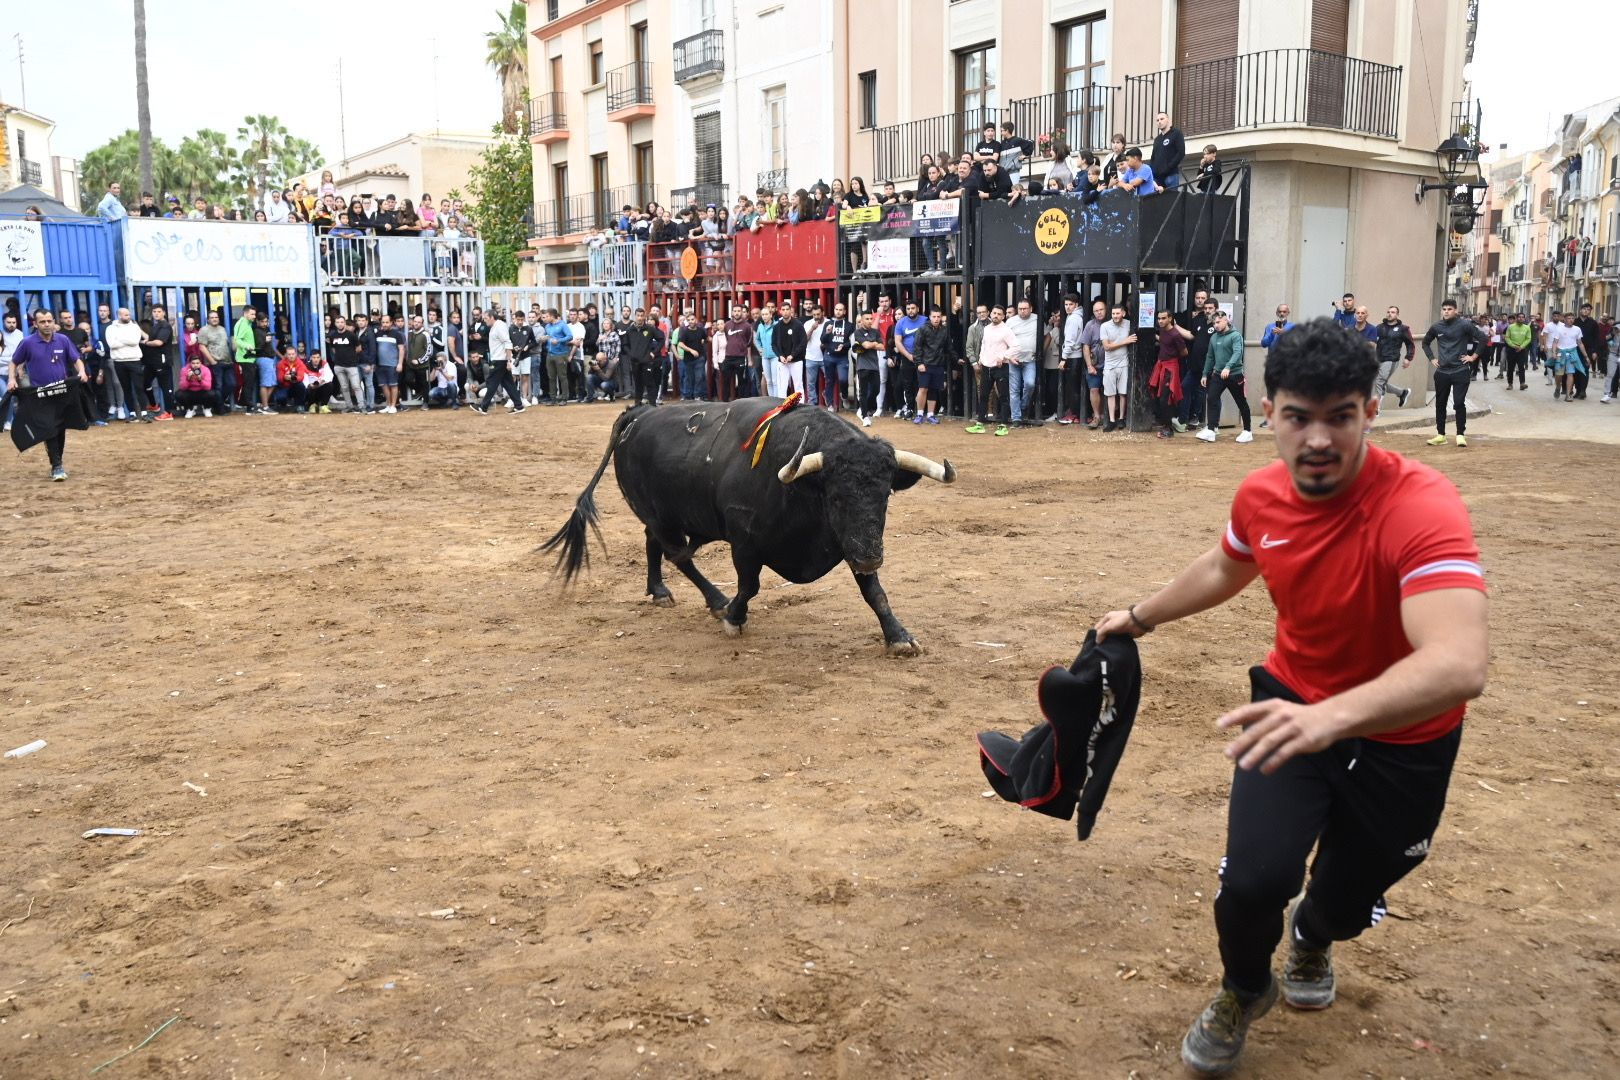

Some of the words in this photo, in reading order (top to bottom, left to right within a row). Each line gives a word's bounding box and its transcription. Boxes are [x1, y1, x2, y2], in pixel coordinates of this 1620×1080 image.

[1038, 214, 1067, 228] COLLA
[183, 238, 223, 262] els
[233, 241, 299, 262] amics
[1040, 240, 1064, 249] DURO
